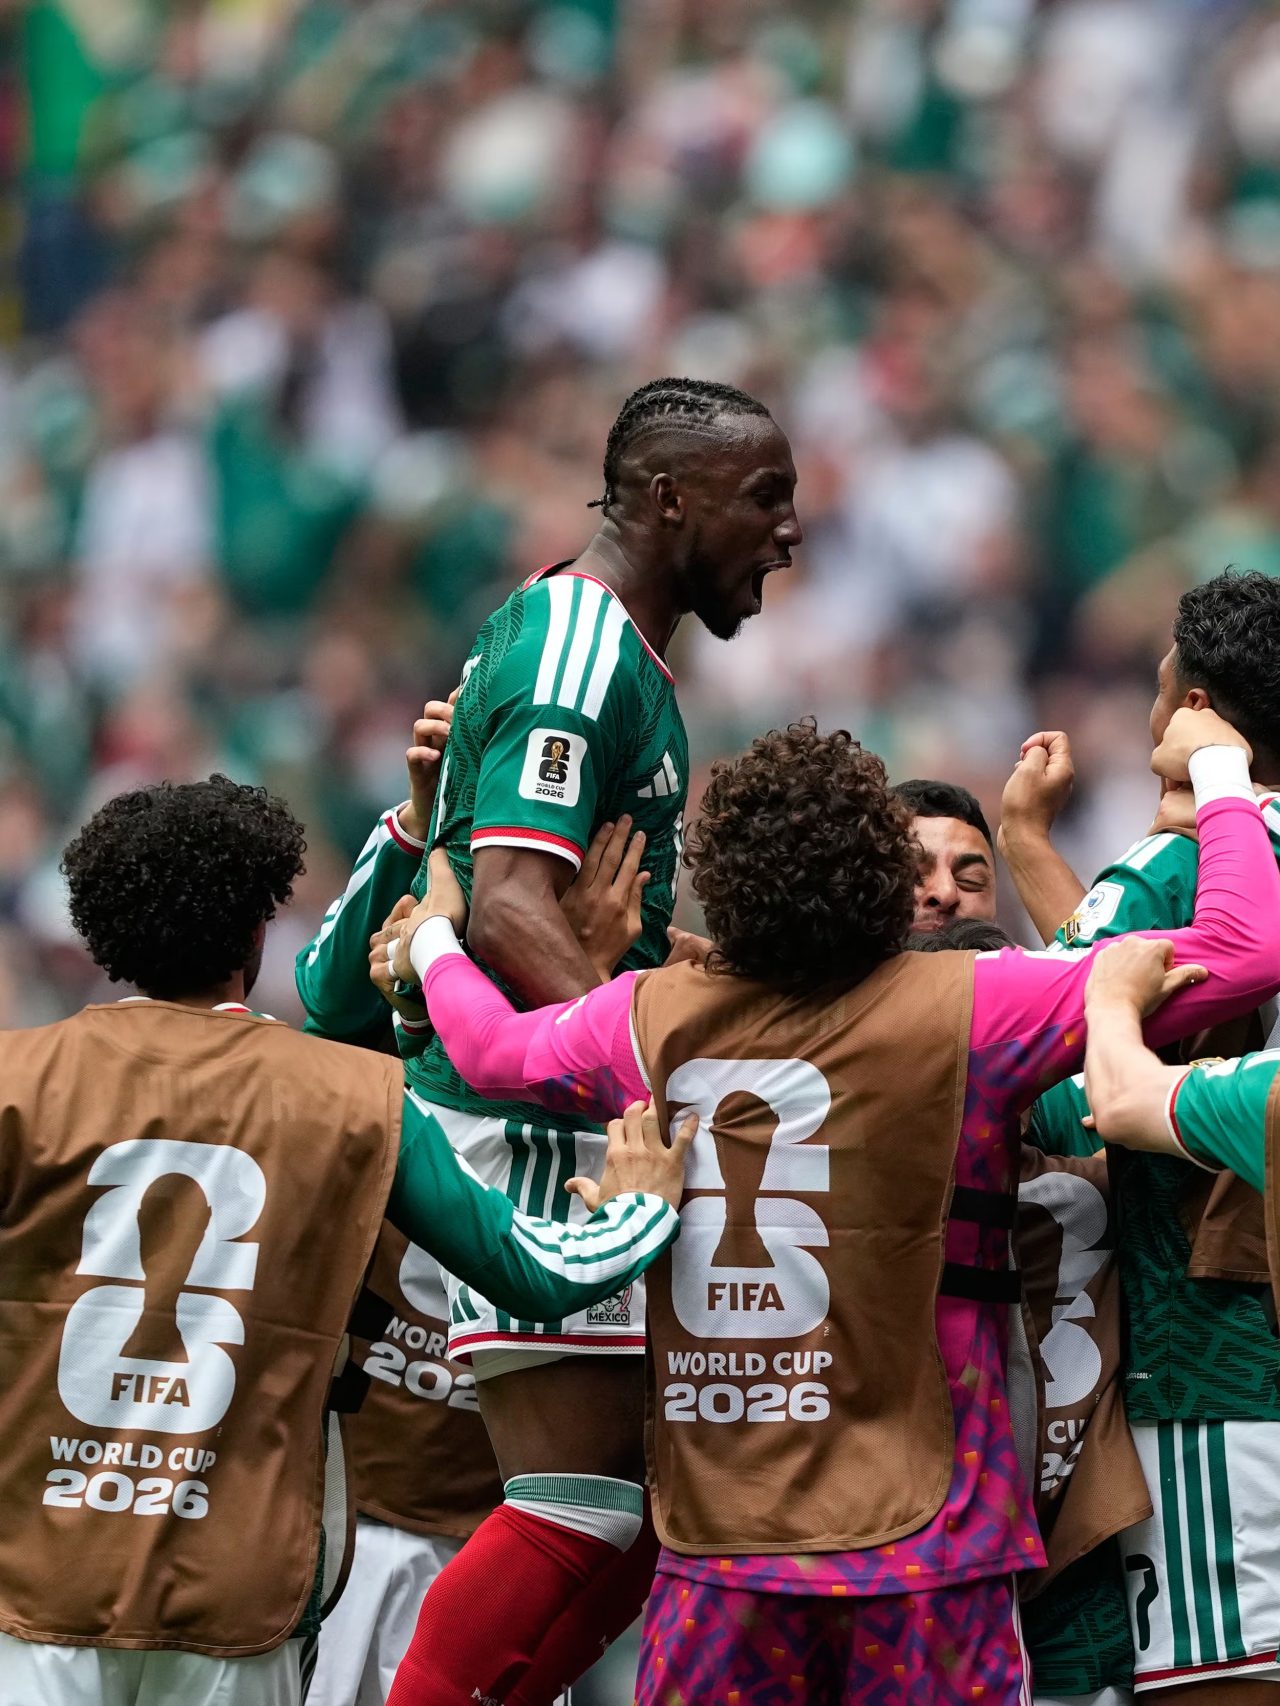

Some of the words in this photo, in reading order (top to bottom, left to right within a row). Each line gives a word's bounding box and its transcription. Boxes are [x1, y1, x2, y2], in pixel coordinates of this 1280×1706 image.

[537, 782, 555, 790] WORLD
[545, 772, 560, 780] FIFA
[535, 787, 564, 799] 2026
[708, 1283, 785, 1311] FIFA
[589, 1310, 628, 1322] MÉXICO
[667, 1352, 766, 1376] WORLD
[773, 1351, 832, 1376] CUP
[111, 1373, 190, 1407] FIFA
[363, 1342, 480, 1412] 202
[664, 1382, 830, 1423] 2026
[1047, 1419, 1087, 1443] CU
[50, 1436, 163, 1469] WORLD
[167, 1447, 217, 1472] CUP
[42, 1469, 209, 1519] 2026
